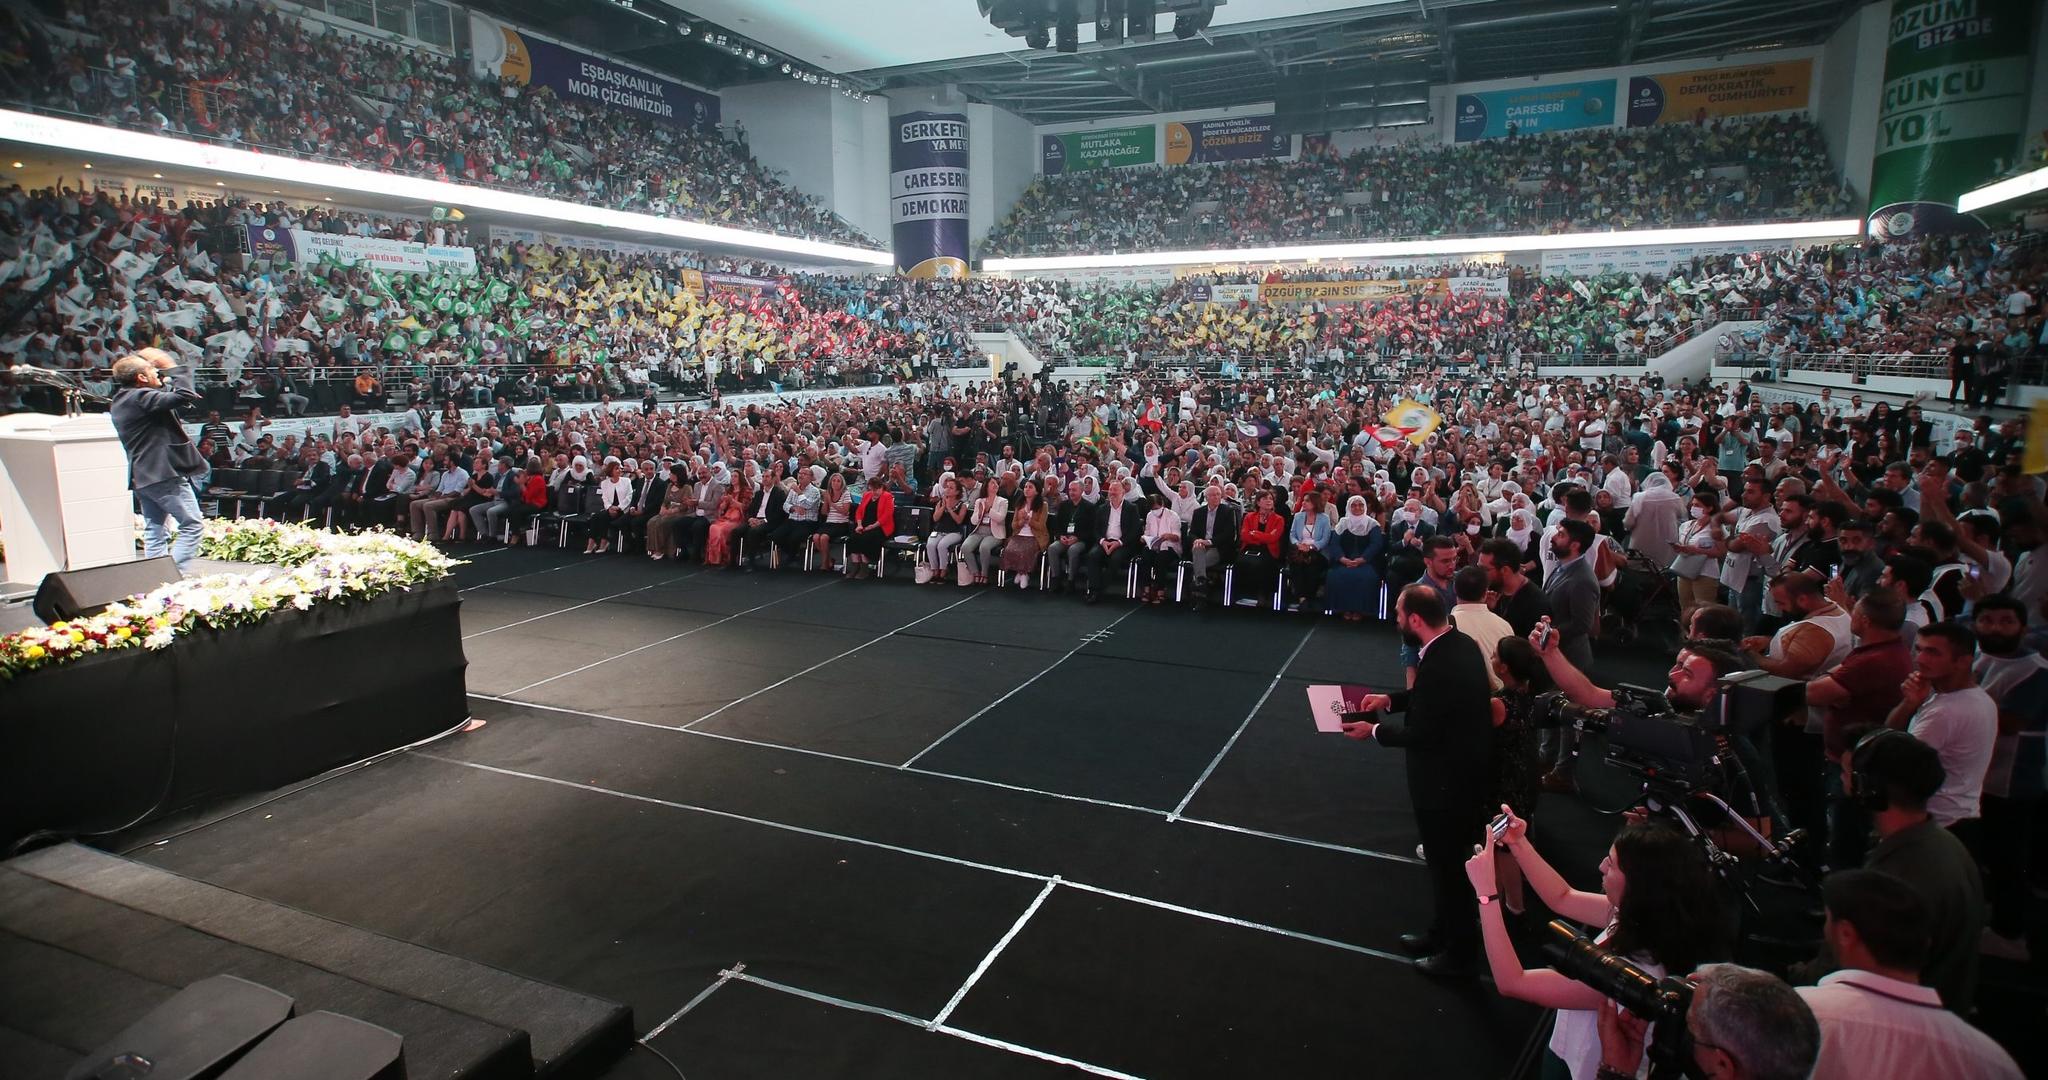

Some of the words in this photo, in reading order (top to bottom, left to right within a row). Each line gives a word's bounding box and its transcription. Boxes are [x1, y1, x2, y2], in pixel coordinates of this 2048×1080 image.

[581, 62, 663, 97] EŞBAŞKANLIK
[1680, 78, 1764, 95] DEMOKRATİK
[568, 78, 601, 99] MOR
[601, 87, 673, 118] ÇİZGİMİZDİR
[1708, 86, 1795, 103] CUMHURİYET
[1203, 121, 1225, 129] KADINA
[1886, 110, 1951, 147] YOL
[932, 140, 947, 150] YA
[1081, 138, 1121, 149] MUTLAKA
[1080, 145, 1141, 159] KAZANACAĞIZ
[1264, 284, 1301, 298] ÖZGÜR
